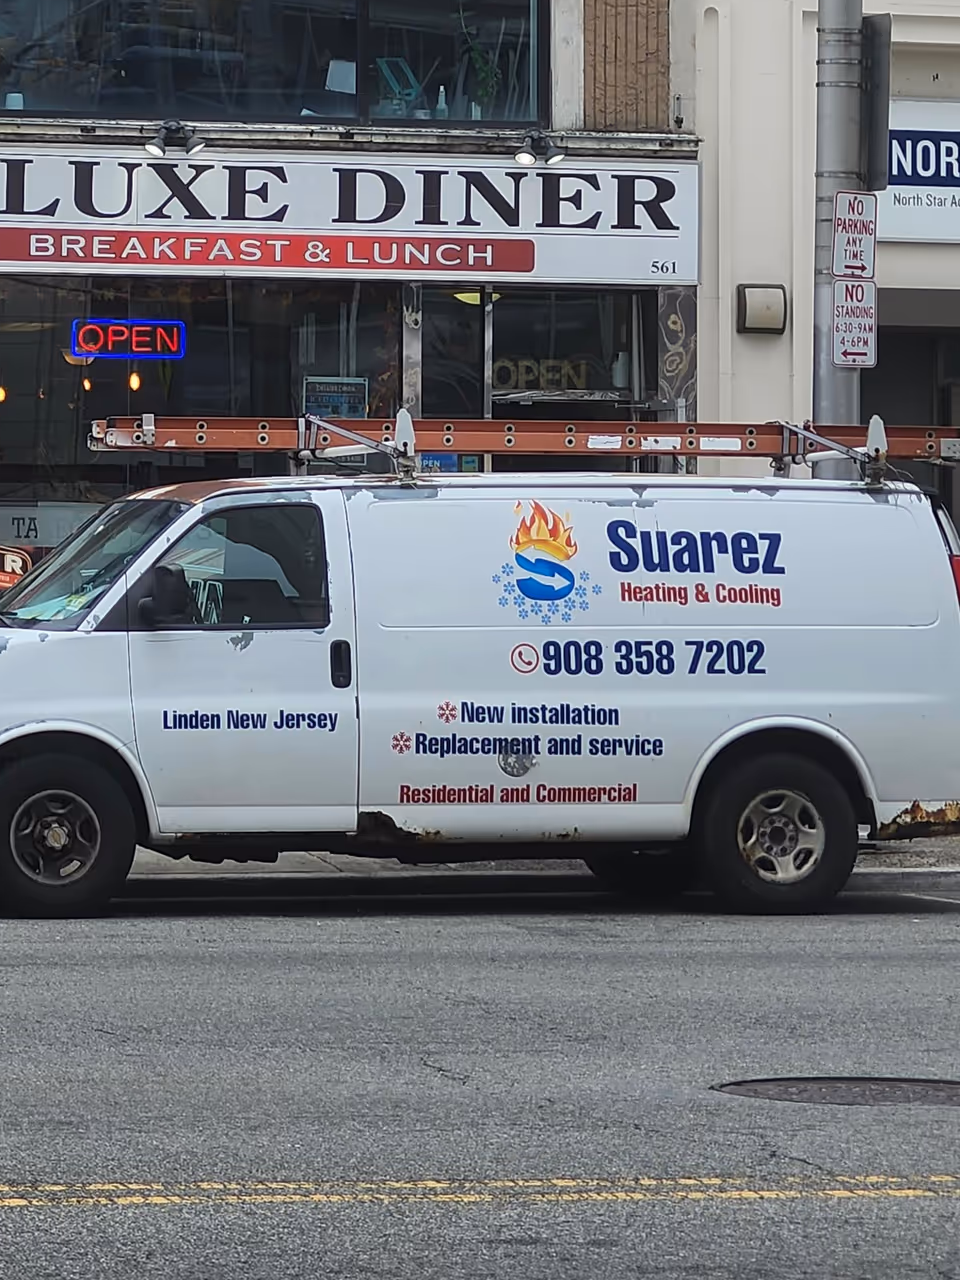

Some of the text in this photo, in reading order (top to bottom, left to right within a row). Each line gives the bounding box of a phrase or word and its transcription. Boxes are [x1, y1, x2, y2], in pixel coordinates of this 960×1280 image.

[891, 139, 960, 178] NOR
[332, 166, 680, 232] DINER
[847, 198, 864, 216] NO
[893, 192, 923, 207] North
[925, 193, 948, 207] Star
[836, 217, 874, 236] PARKING
[29, 233, 495, 267] BREAKFAST & LUNCH
[845, 236, 863, 248] ANY
[843, 249, 864, 261] TIME
[650, 260, 679, 275] 561
[845, 284, 864, 303] NO
[835, 305, 873, 319] STANDING
[76, 324, 179, 353] OPEN
[835, 322, 873, 334] 6:30-9AM
[840, 335, 869, 348] 4-6PM
[493, 359, 587, 391] OPEN
[606, 519, 786, 575] Suarez
[619, 581, 781, 608] Heating & Cooling
[542, 639, 767, 675] 908 358 7202
[162, 709, 338, 734] Linden New Jersey
[460, 700, 620, 726] New installation
[414, 732, 663, 758] Replacement and service
[399, 783, 638, 804] Residential and Commercial
